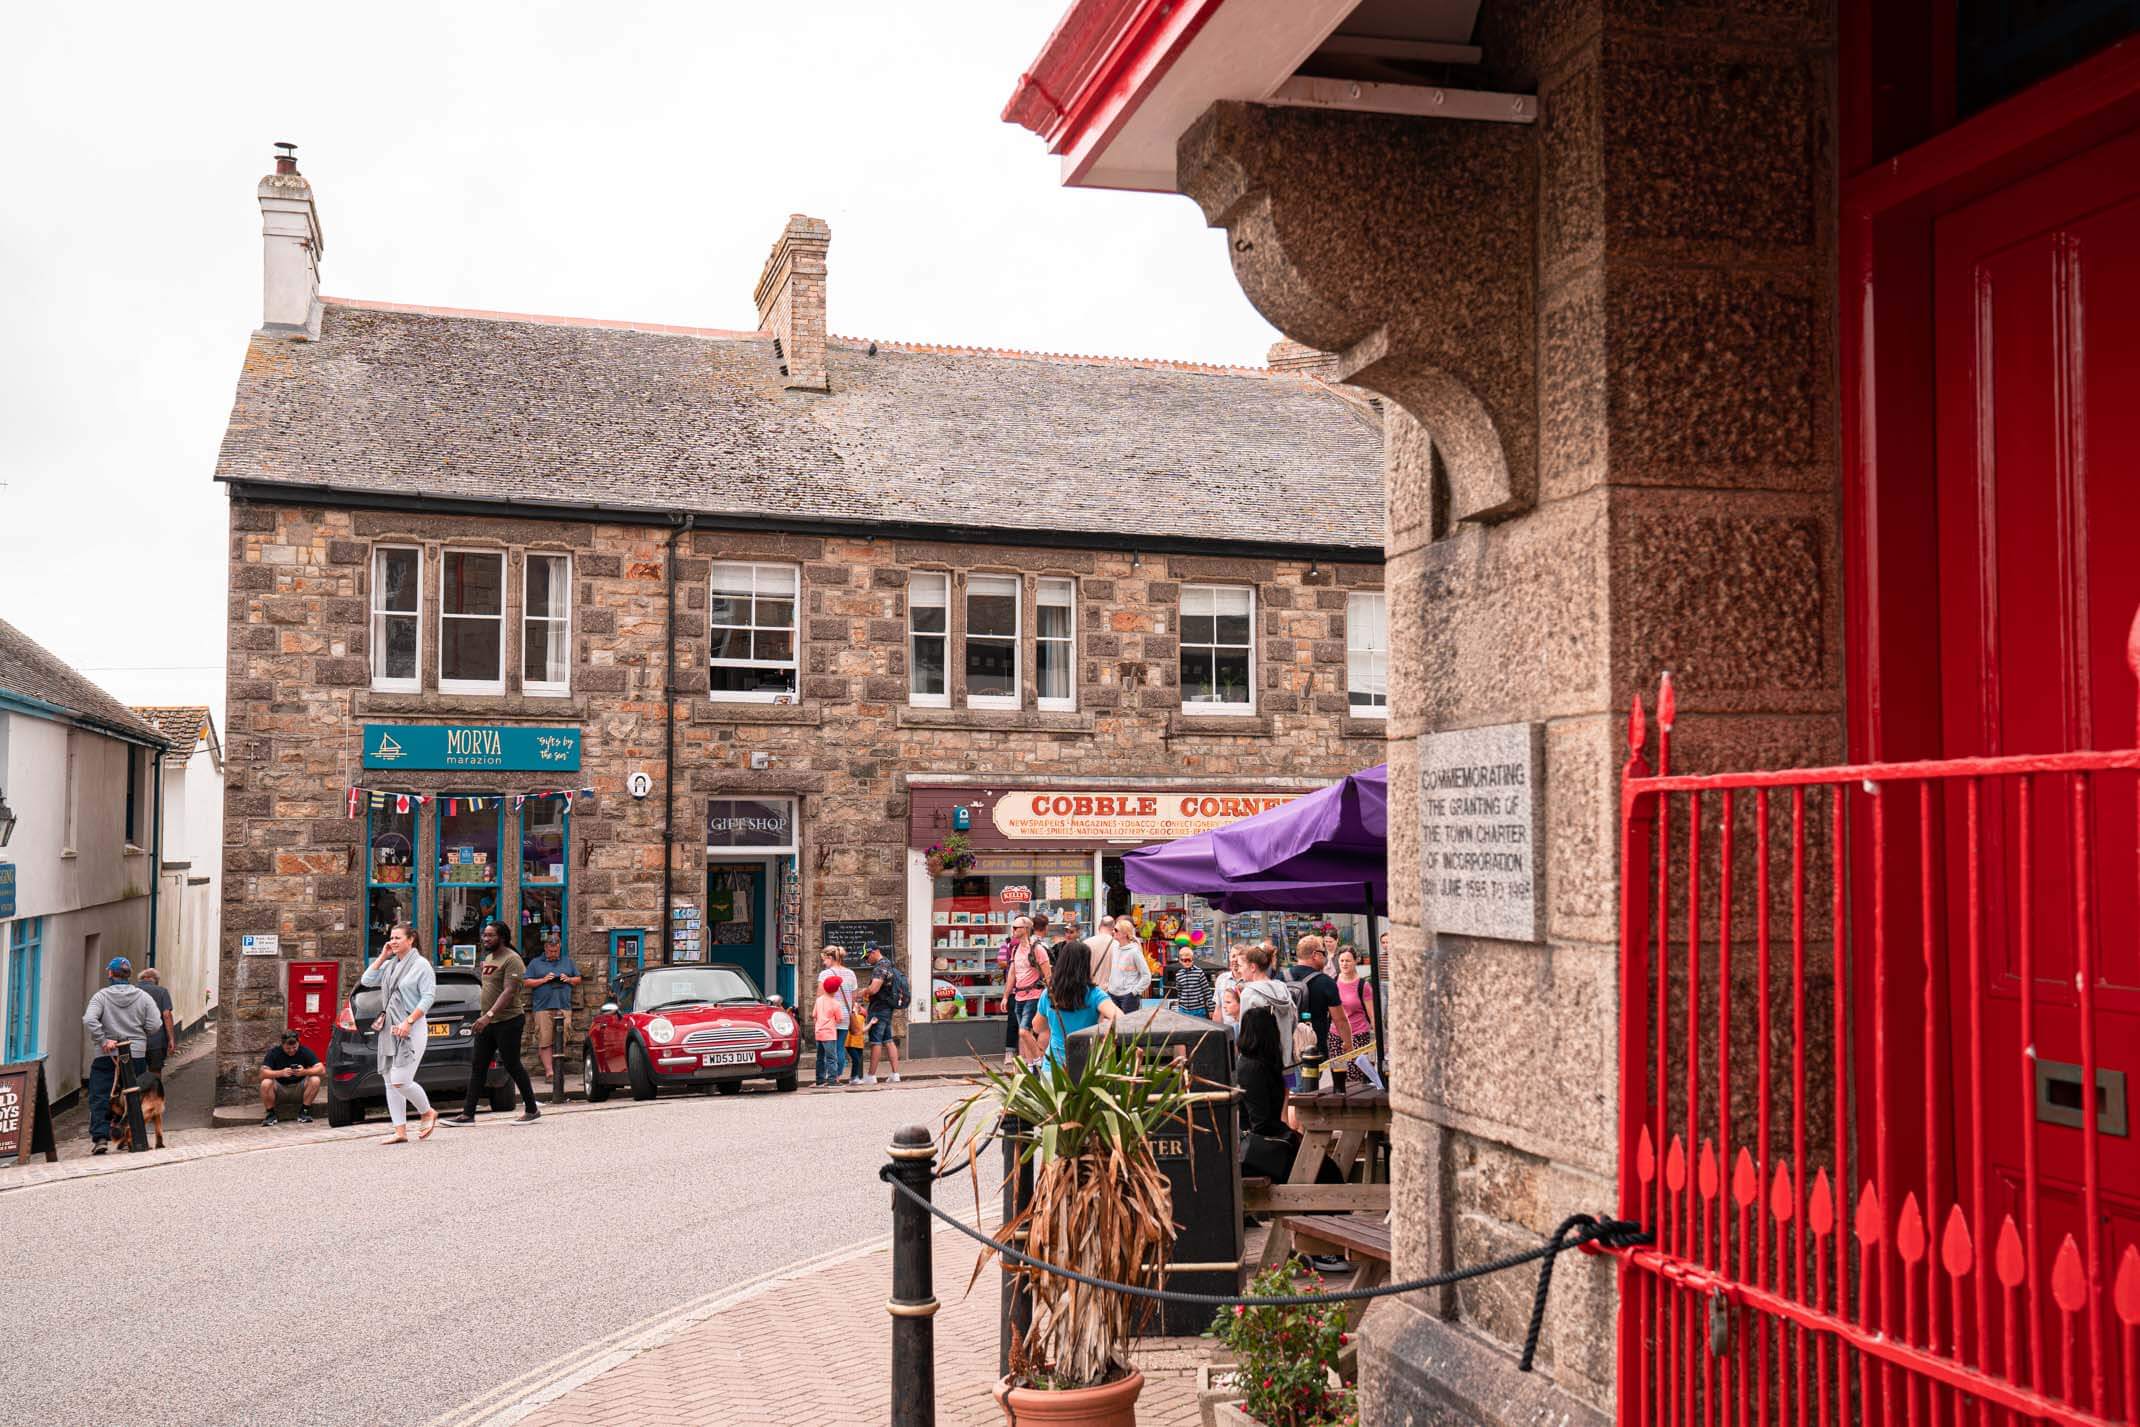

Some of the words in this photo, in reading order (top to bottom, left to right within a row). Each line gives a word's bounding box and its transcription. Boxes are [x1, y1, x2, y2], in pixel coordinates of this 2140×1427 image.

[447, 730, 502, 755] MORVA
[562, 736, 575, 749] by
[447, 756, 502, 765] marazion
[1422, 763, 1525, 790] COMMEMORATING
[1031, 795, 1157, 816] COBBLE
[1180, 796, 1297, 817] CORNE
[1427, 799, 1446, 816] THE
[1449, 797, 1501, 816] GRANTING
[1505, 795, 1519, 814] OF
[711, 817, 744, 830] GIFT
[748, 817, 787, 830] SHOP
[1009, 819, 1065, 827] NEWSPAPERS
[1423, 825, 1441, 842] THE
[1444, 825, 1472, 842] TOWN
[1476, 824, 1526, 843] CHARTER
[1427, 852, 1439, 869] OF
[1442, 852, 1522, 872] INCORPORATION
[1441, 878, 1462, 896] JUNE
[1491, 880, 1504, 899] TO
[709, 1053, 734, 1064] WD53
[736, 1052, 754, 1062] DUV
[0, 1093, 18, 1107] LD
